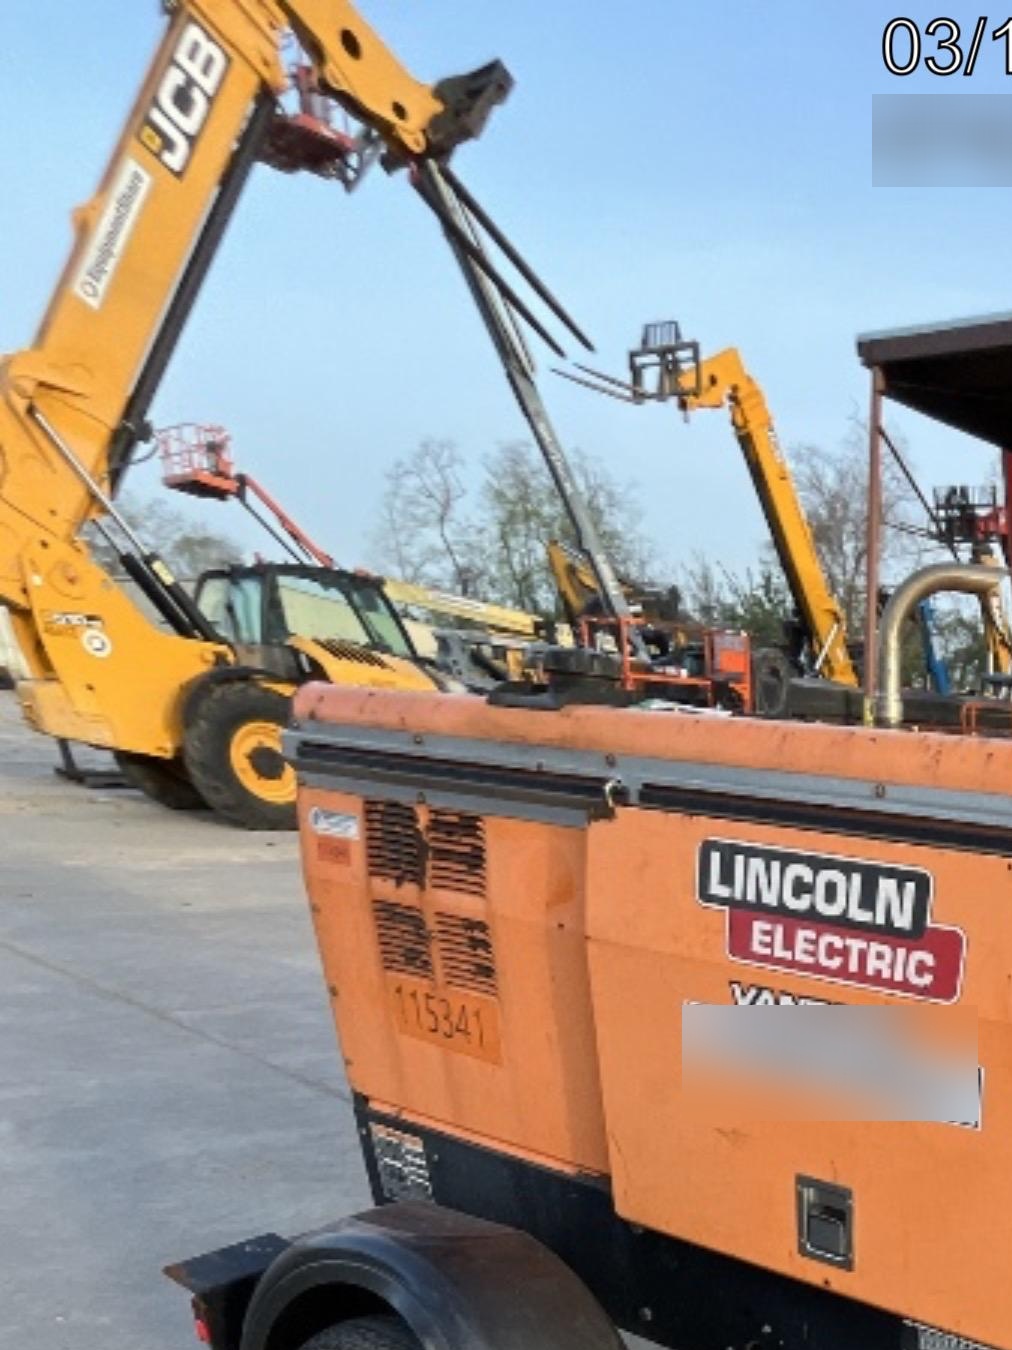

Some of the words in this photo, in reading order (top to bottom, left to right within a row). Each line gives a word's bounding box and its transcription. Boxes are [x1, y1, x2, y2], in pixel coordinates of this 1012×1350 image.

[148, 24, 227, 172] JCB
[707, 850, 918, 930] LINCOLN
[750, 919, 936, 988] ELECTRIC
[394, 984, 485, 1048] 115341
